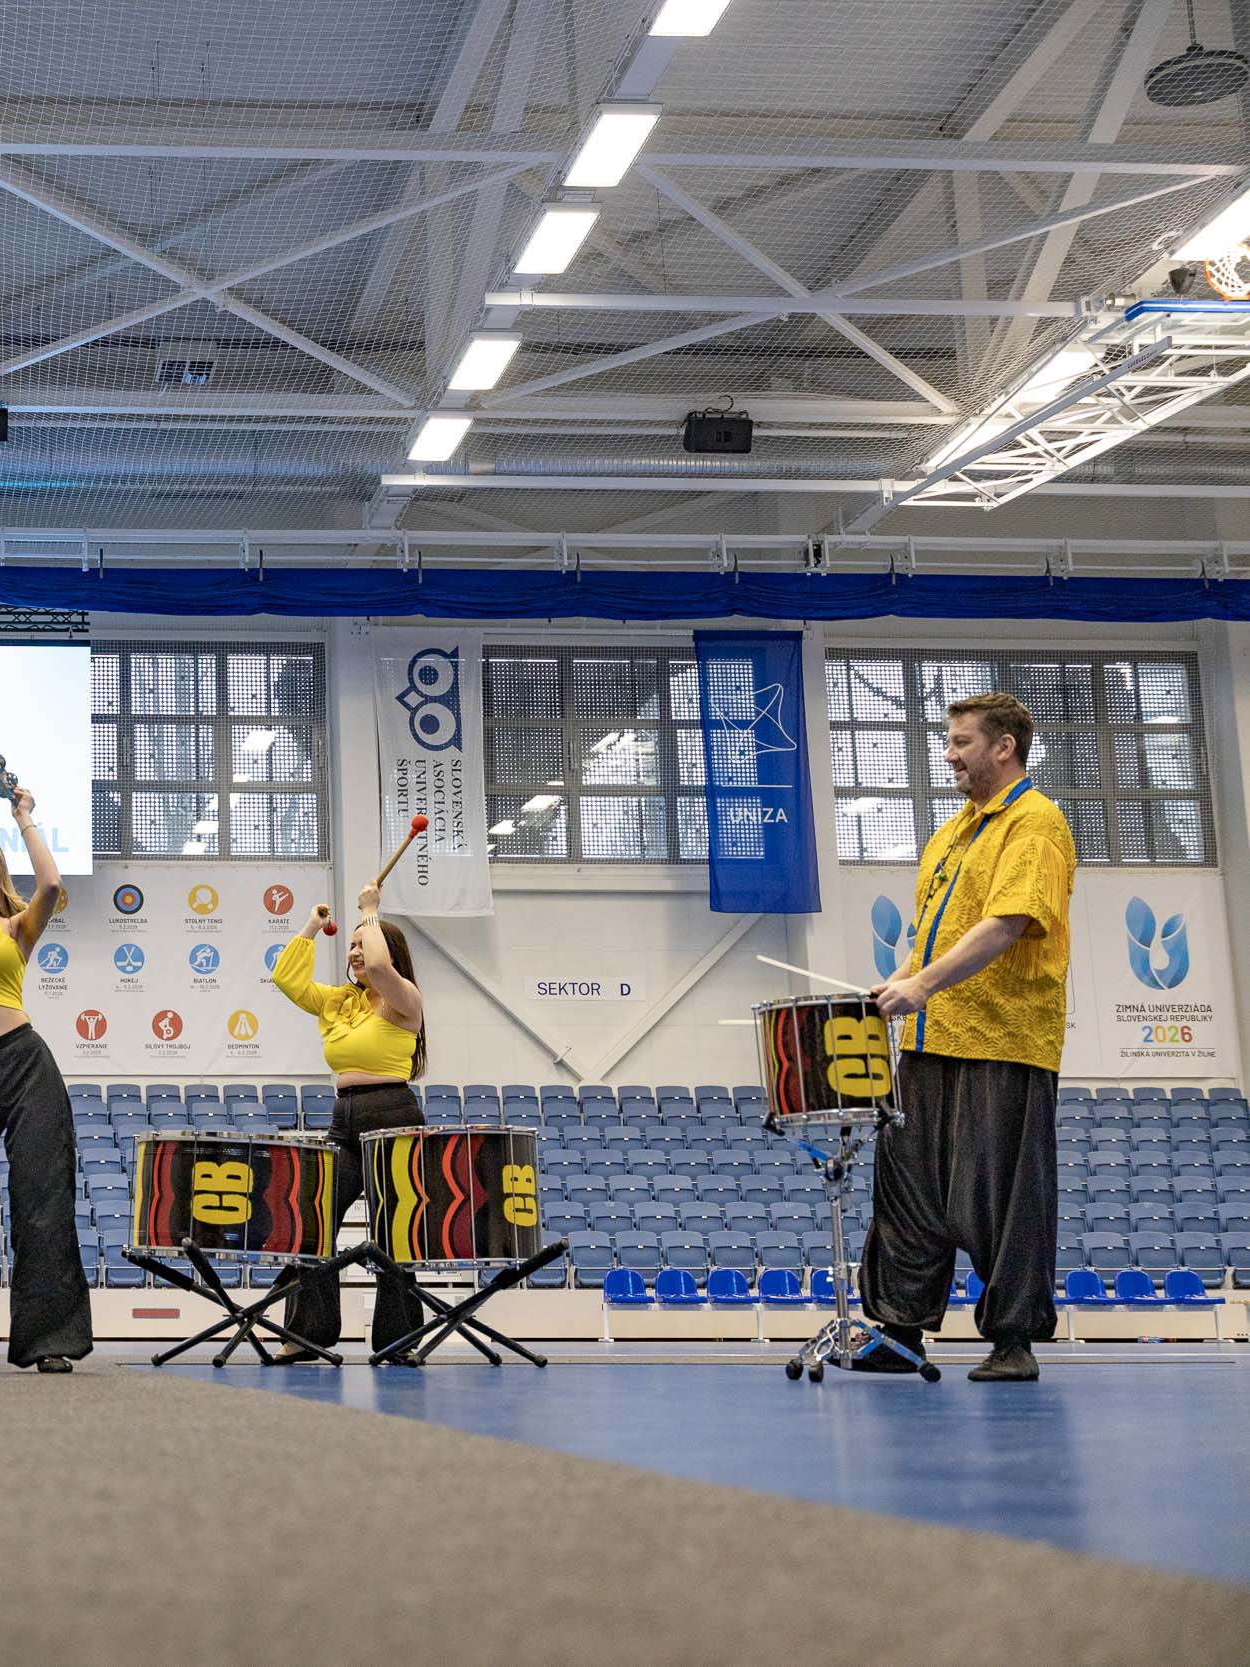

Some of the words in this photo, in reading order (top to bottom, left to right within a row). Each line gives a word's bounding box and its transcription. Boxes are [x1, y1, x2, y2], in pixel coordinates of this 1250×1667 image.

[396, 759, 412, 818] ŠPORTU
[433, 760, 449, 843] ASOCIÁCIA
[450, 759, 467, 850] SLOVENSKÁ
[414, 759, 432, 886] UNIVERTNÉHO
[729, 807, 788, 824] UNIZA
[537, 981, 601, 996] SEKTOR
[620, 983, 631, 996] D
[1115, 1003, 1146, 1013] ZIMNÁ
[1148, 1003, 1212, 1013] UNIVERZIÁDA
[1116, 1014, 1168, 1022] SLOVENSKEJ
[1170, 1014, 1213, 1022] REPUBLIKY
[1141, 1025, 1193, 1043] 2026
